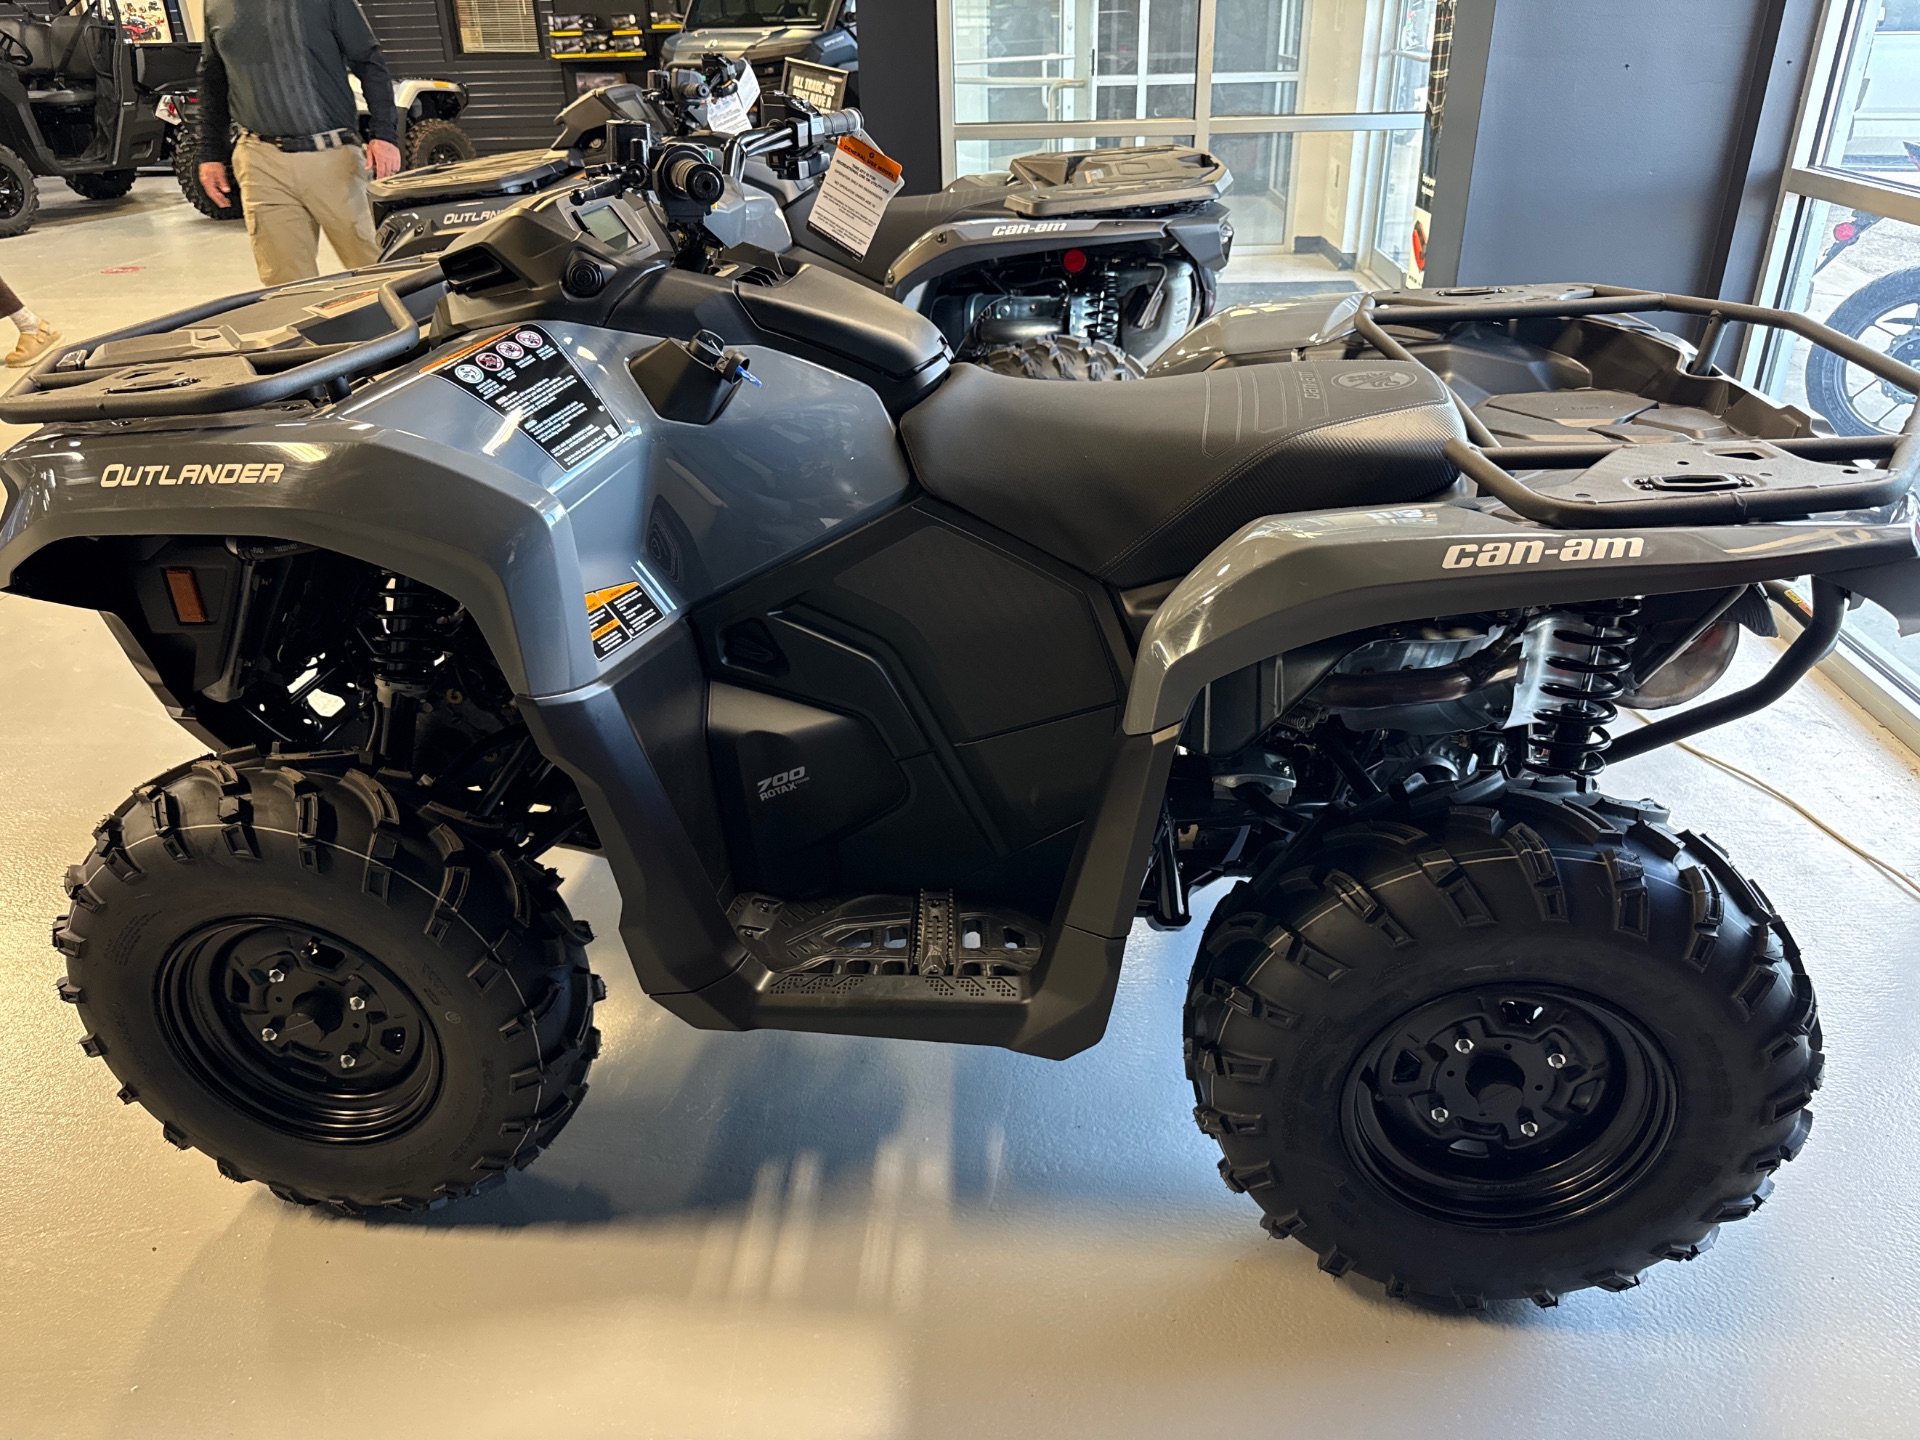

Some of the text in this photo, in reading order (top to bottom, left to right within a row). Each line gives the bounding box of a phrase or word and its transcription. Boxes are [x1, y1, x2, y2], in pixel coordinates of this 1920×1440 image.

[793, 75, 804, 89] ALL
[804, 78, 836, 97] TRADE-INS
[810, 92, 827, 108] HAVE
[826, 97, 832, 109] A
[843, 145, 895, 179] GENERAL USE MODEL
[443, 209, 507, 225] OUTLAN
[992, 222, 1067, 237] can-am
[100, 463, 285, 488] OUTLANDER
[1442, 537, 1645, 569] can-am
[757, 766, 806, 793] 700
[759, 782, 797, 801] ROTAX
